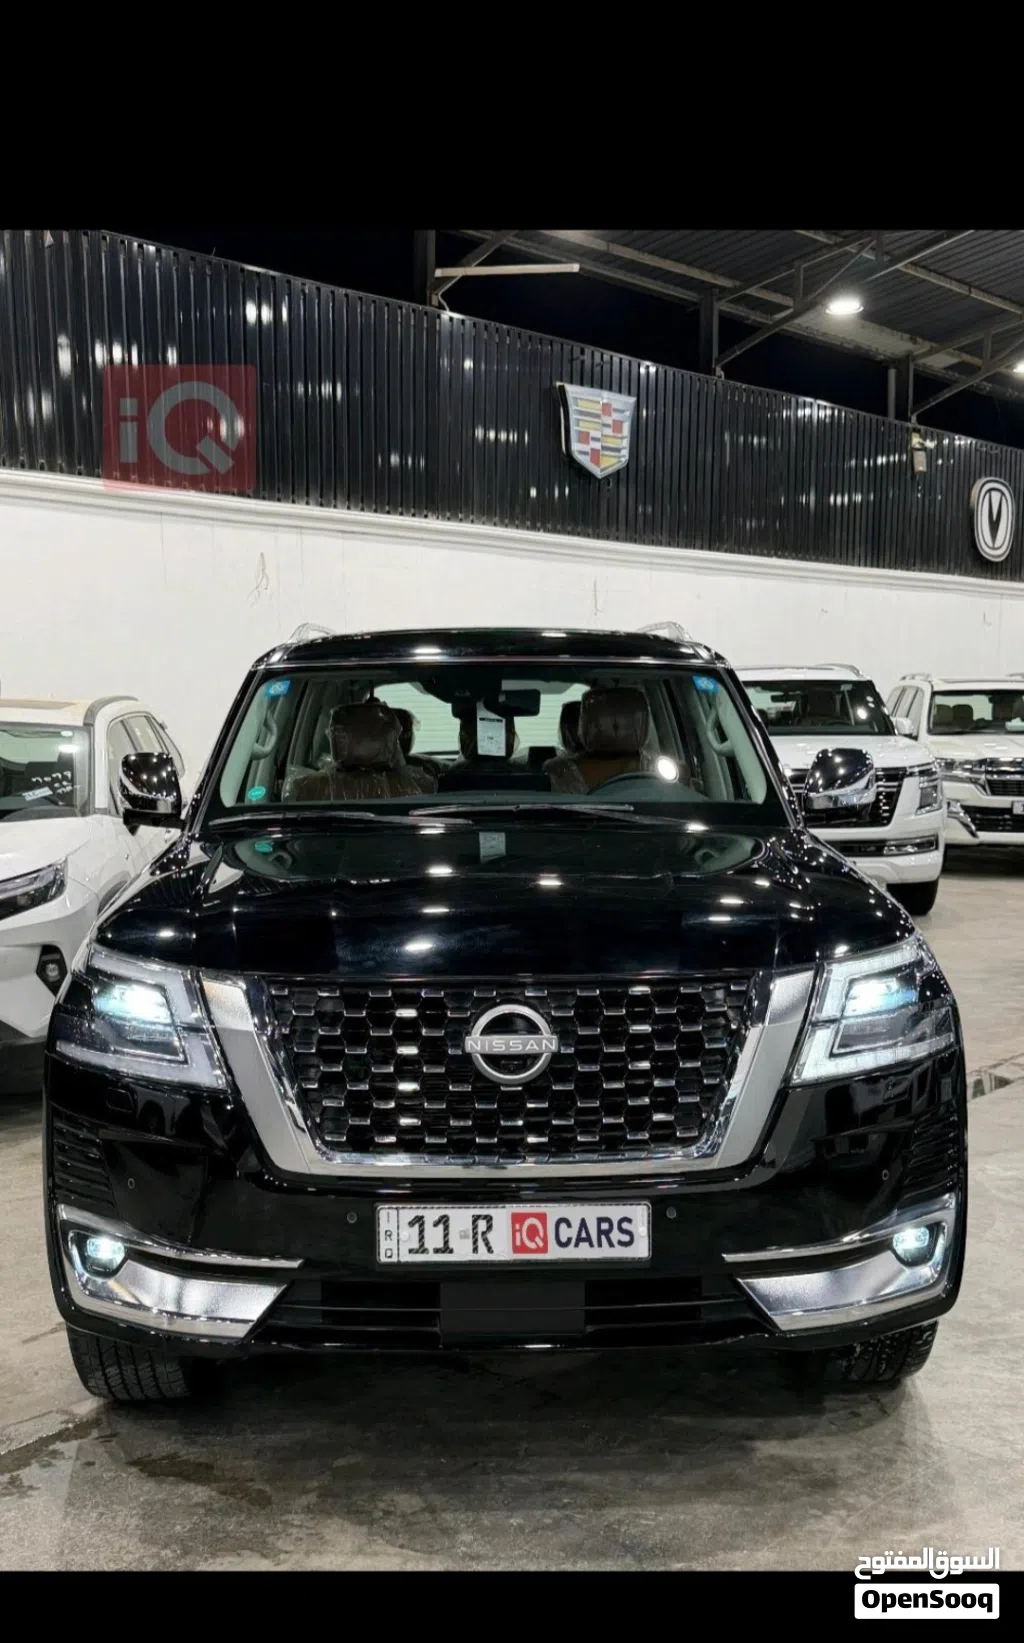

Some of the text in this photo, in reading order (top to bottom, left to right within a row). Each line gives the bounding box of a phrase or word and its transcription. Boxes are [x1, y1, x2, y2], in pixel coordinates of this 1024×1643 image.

[467, 1039, 556, 1051] NISSAN
[408, 1214, 454, 1255] 11
[471, 1213, 494, 1255] R
[554, 1216, 635, 1248] CARS
